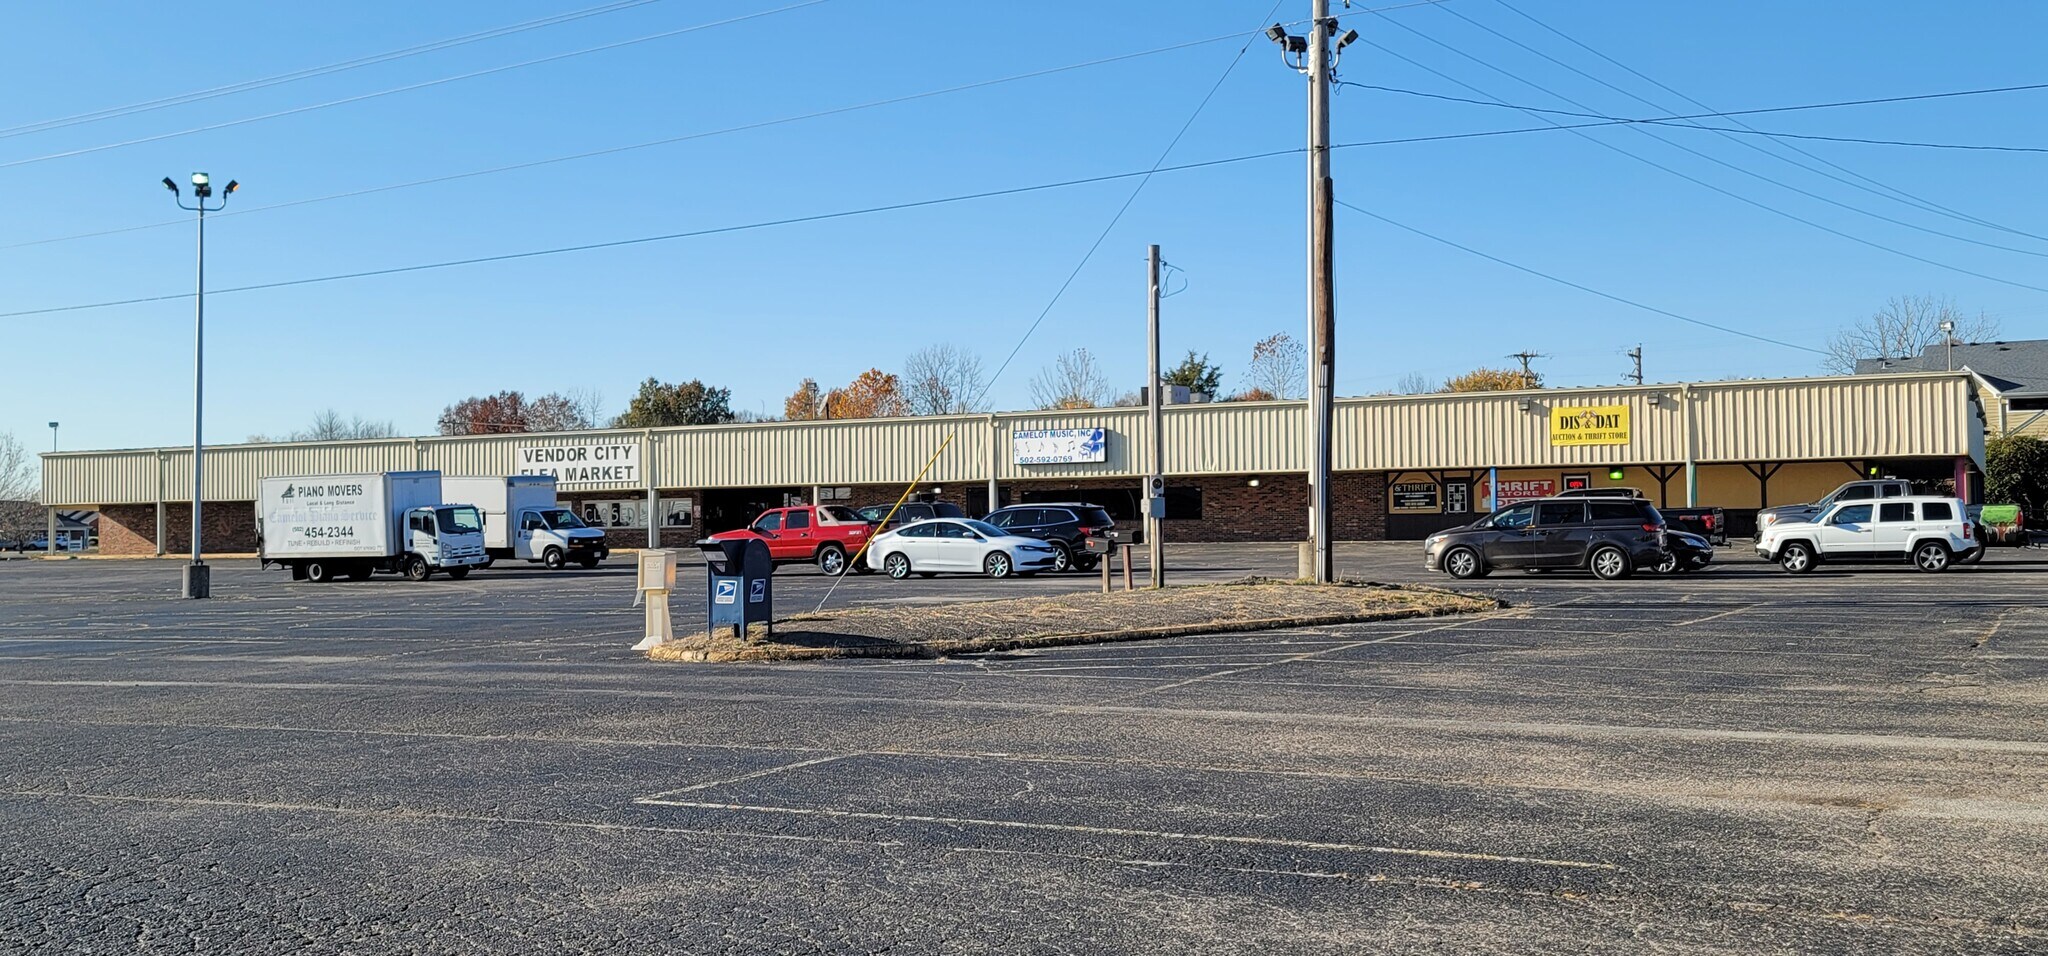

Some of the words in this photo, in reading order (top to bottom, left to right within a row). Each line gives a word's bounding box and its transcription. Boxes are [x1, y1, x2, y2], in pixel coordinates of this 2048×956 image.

[1560, 415, 1580, 430] DIS
[1596, 414, 1620, 428] DAT
[1014, 430, 1048, 439] CAMELOT
[524, 447, 588, 463] VENDOR
[594, 446, 632, 460] CITY
[1020, 456, 1072, 464] 502-592-0769
[566, 466, 634, 482] MARKET
[298, 486, 324, 498] PIANO
[328, 484, 362, 496] MOVERS
[304, 526, 354, 538] 454-2344
